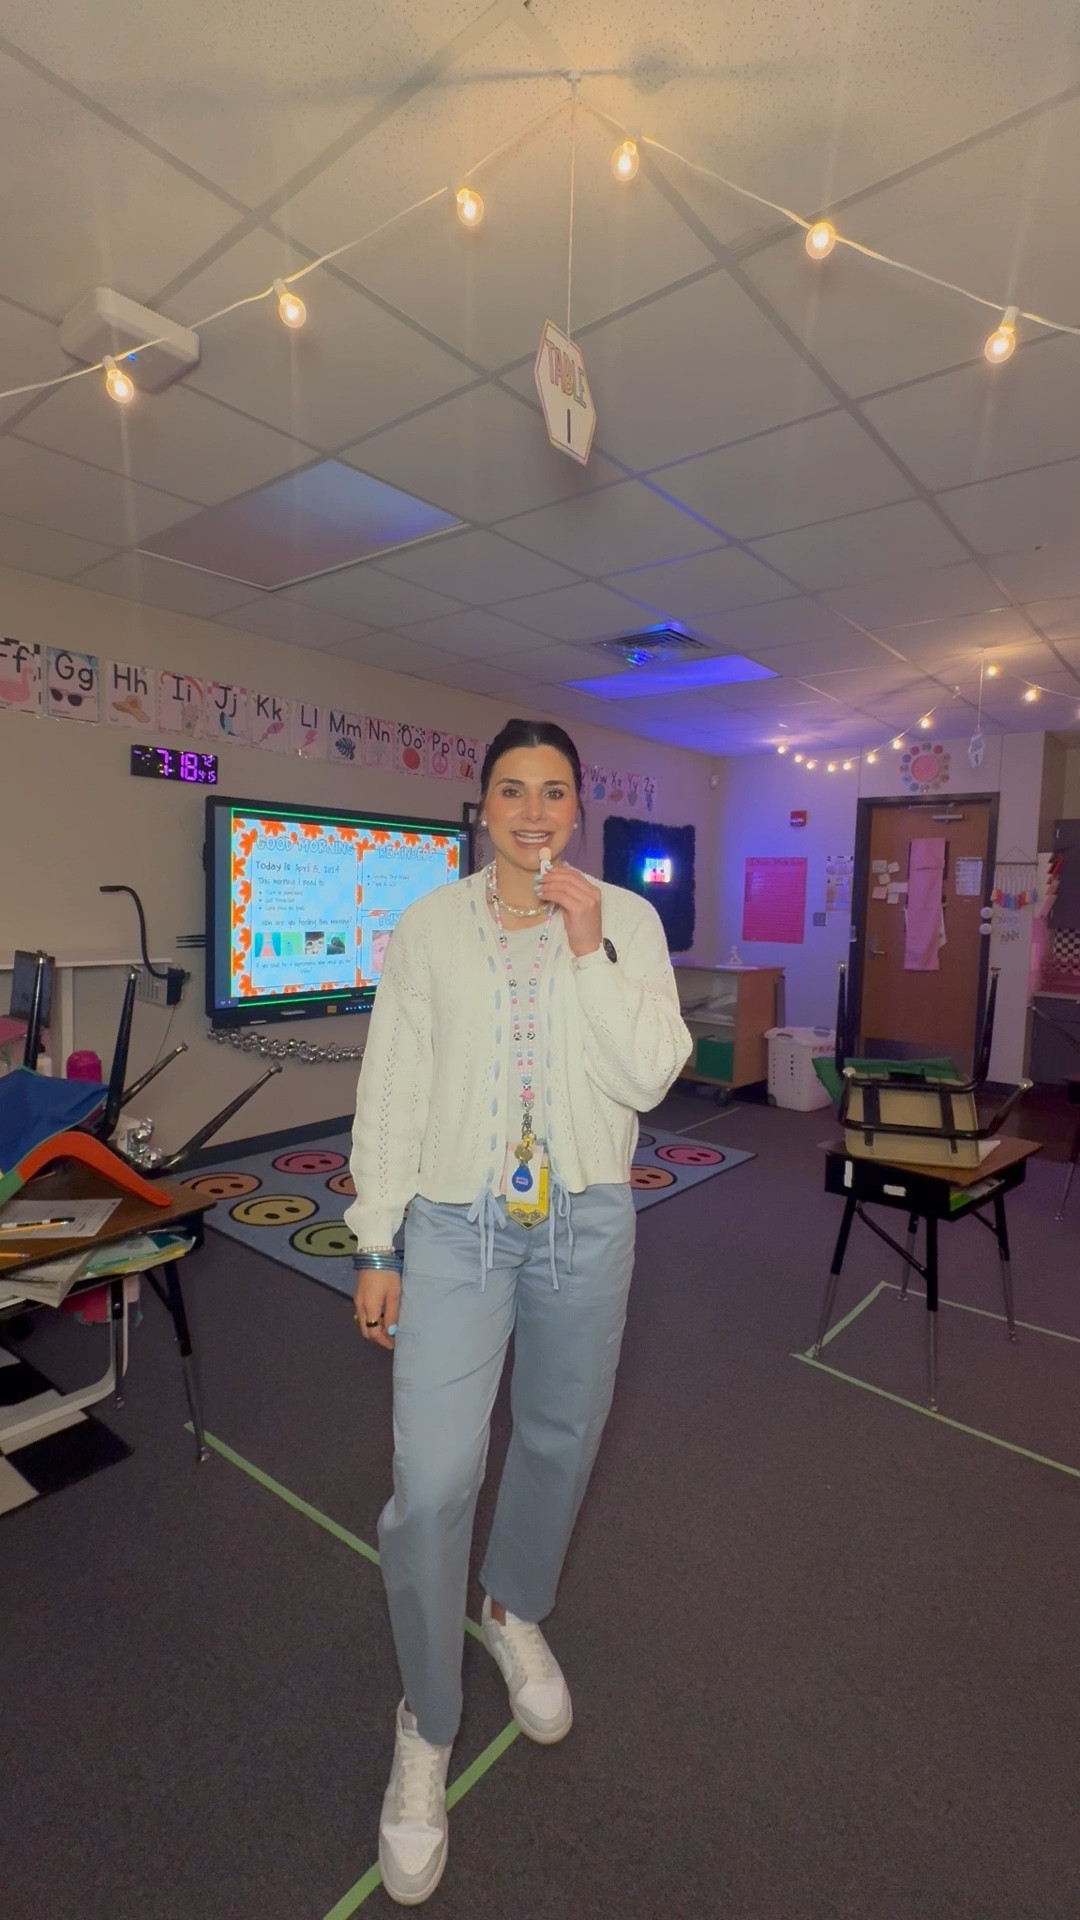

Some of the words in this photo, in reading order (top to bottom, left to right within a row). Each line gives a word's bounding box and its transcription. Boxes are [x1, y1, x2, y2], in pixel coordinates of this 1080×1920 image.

[545, 338, 587, 409] TABLE
[55, 653, 94, 691] Gg
[114, 664, 148, 695] Hh
[172, 675, 192, 702] Ii
[214, 685, 238, 718] Jj
[257, 694, 283, 721] Kk
[301, 705, 318, 729] Ll
[329, 711, 362, 738] Mm
[368, 719, 390, 743] Nn
[401, 726, 423, 749] Oo
[432, 731, 450, 758] Pp
[457, 738, 478, 765] Qq
[256, 861, 281, 872] Today
[284, 862, 291, 871] is
[257, 833, 293, 852] GOOD
[298, 837, 355, 856] MORNING
